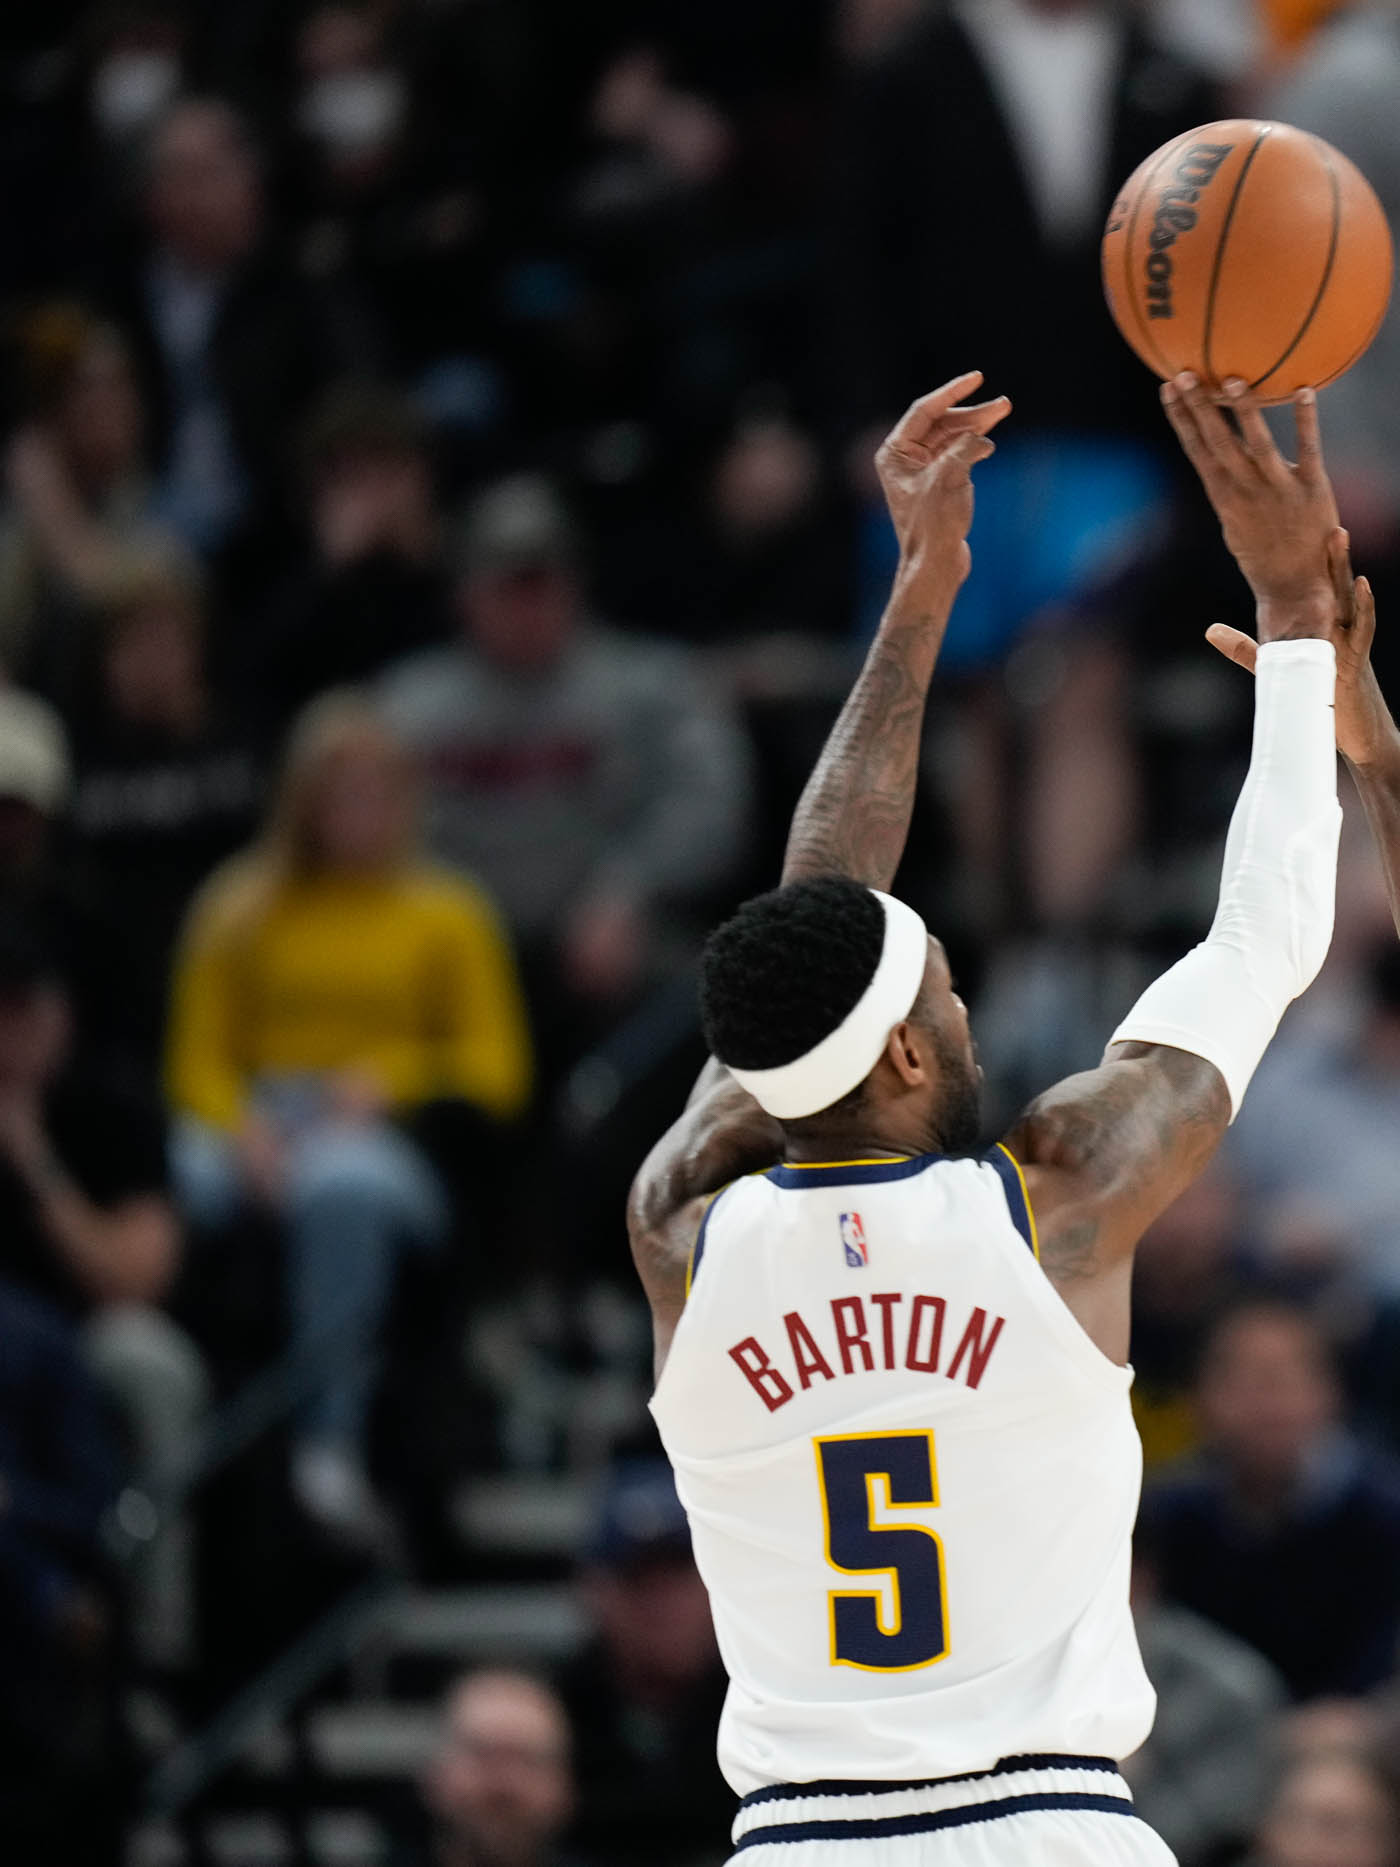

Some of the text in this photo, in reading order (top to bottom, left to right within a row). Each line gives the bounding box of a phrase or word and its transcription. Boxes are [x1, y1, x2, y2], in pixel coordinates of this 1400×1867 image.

[1146, 143, 1236, 319] Wilson
[727, 1292, 1006, 1413] BARTON
[811, 1428, 951, 1672] 5
